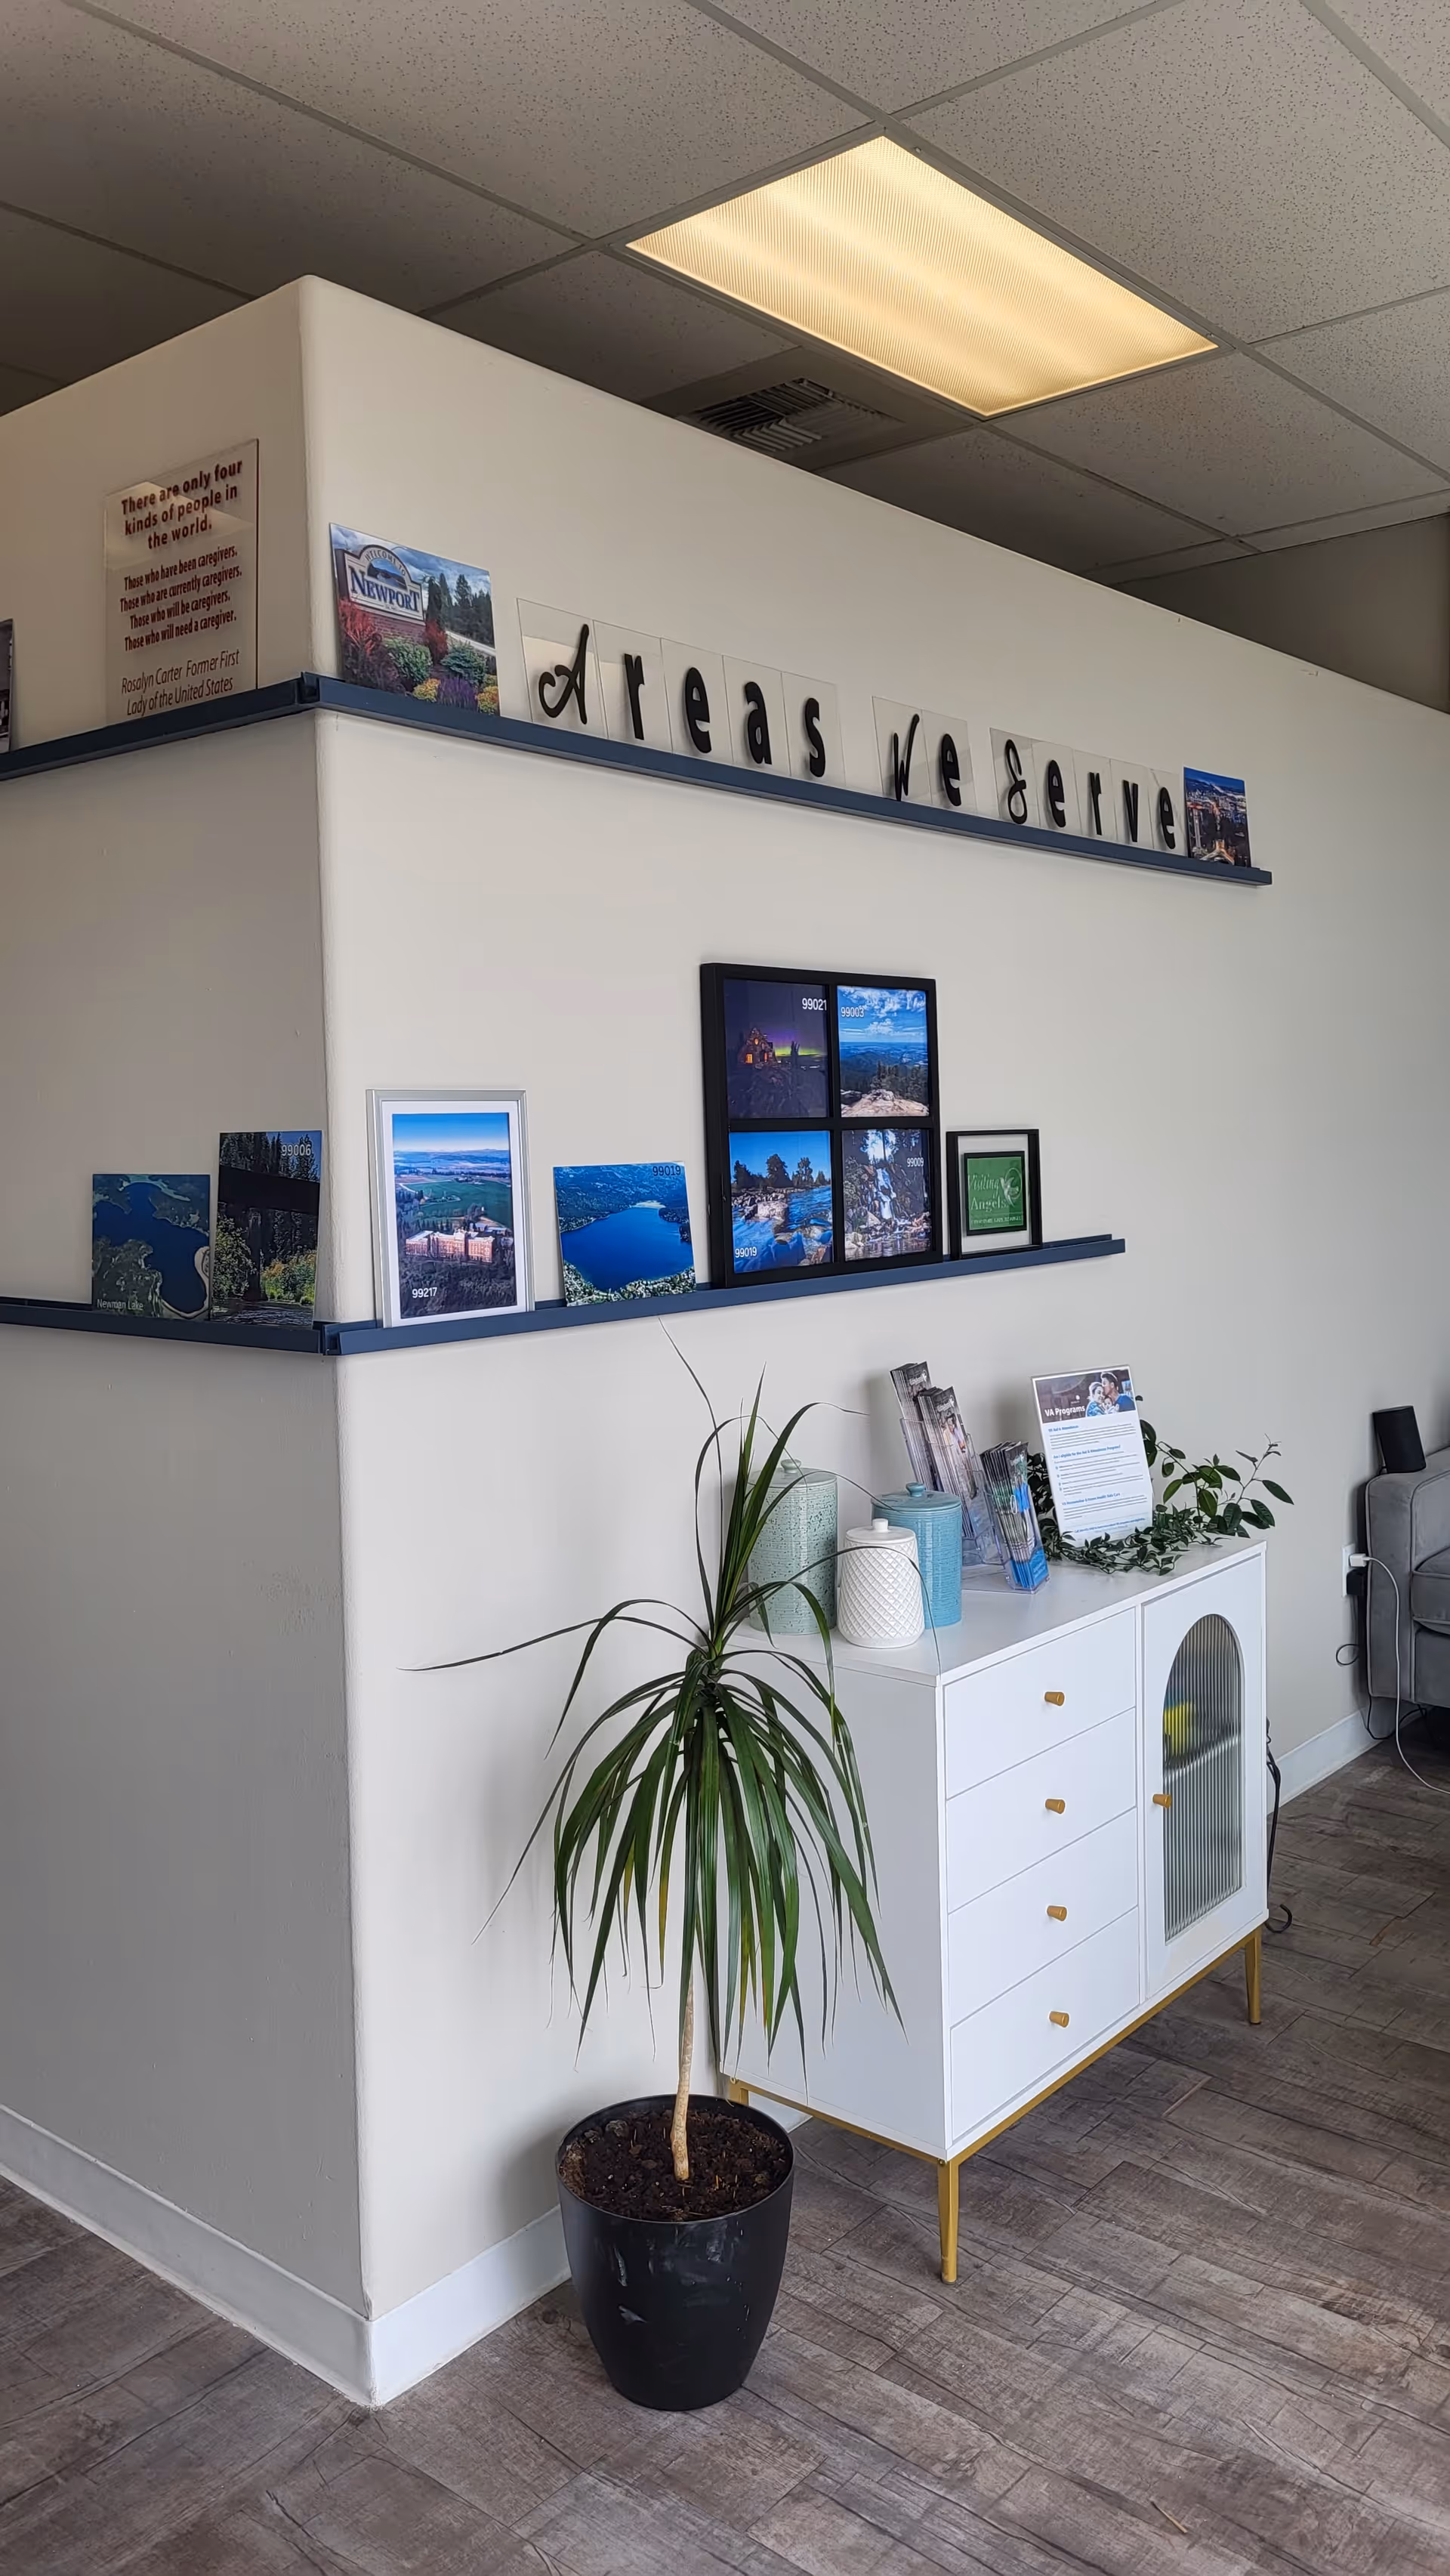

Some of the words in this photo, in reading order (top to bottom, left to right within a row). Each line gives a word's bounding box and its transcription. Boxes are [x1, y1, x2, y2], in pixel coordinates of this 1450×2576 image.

[122, 493, 156, 514] There
[159, 485, 179, 502] are
[182, 471, 211, 493] only
[214, 461, 242, 481] four
[125, 511, 157, 536] kinds
[162, 503, 174, 522] of
[177, 490, 221, 521] people
[226, 484, 237, 500] in
[148, 532, 168, 549] the
[171, 514, 211, 541] world.
[124, 576, 143, 591] Those
[145, 569, 159, 585] who
[161, 565, 177, 579] have
[179, 558, 196, 574] been
[198, 545, 238, 567] caregivers.
[120, 598, 139, 613] Those
[140, 591, 155, 606] who
[156, 588, 168, 601] are
[169, 574, 201, 598] currently
[202, 565, 242, 587] caregivers.
[348, 565, 420, 613] NEWPORT
[130, 614, 149, 629] Those
[151, 607, 165, 623] who
[167, 601, 179, 618] will
[181, 600, 190, 615] be
[191, 590, 230, 611] caregivers.
[125, 636, 143, 651] Those
[145, 629, 160, 646] who
[161, 624, 174, 641] will
[175, 619, 193, 638] need
[194, 621, 199, 632] a
[200, 610, 236, 630] caregiver.
[122, 672, 153, 694] Rosalyn
[156, 666, 183, 685] Carter
[186, 657, 218, 678] Former
[220, 649, 239, 669] First
[127, 696, 148, 717] Lady
[149, 691, 159, 710] of
[159, 689, 173, 708] the
[175, 680, 204, 704] United
[205, 677, 233, 697] States
[538, 623, 826, 777] Areas
[893, 714, 962, 806] We
[1005, 739, 1176, 850] Serve
[802, 998, 827, 1011] 99021
[841, 1007, 864, 1018] 99003
[282, 1144, 310, 1156] 99006
[906, 1157, 924, 1167] 99009
[652, 1165, 680, 1176] 99019
[735, 1246, 757, 1258] 99019
[97, 1299, 126, 1308] Newman
[128, 1299, 143, 1311] Lake
[412, 1286, 437, 1299] 99217
[1056, 1405, 1085, 1416] Programs
